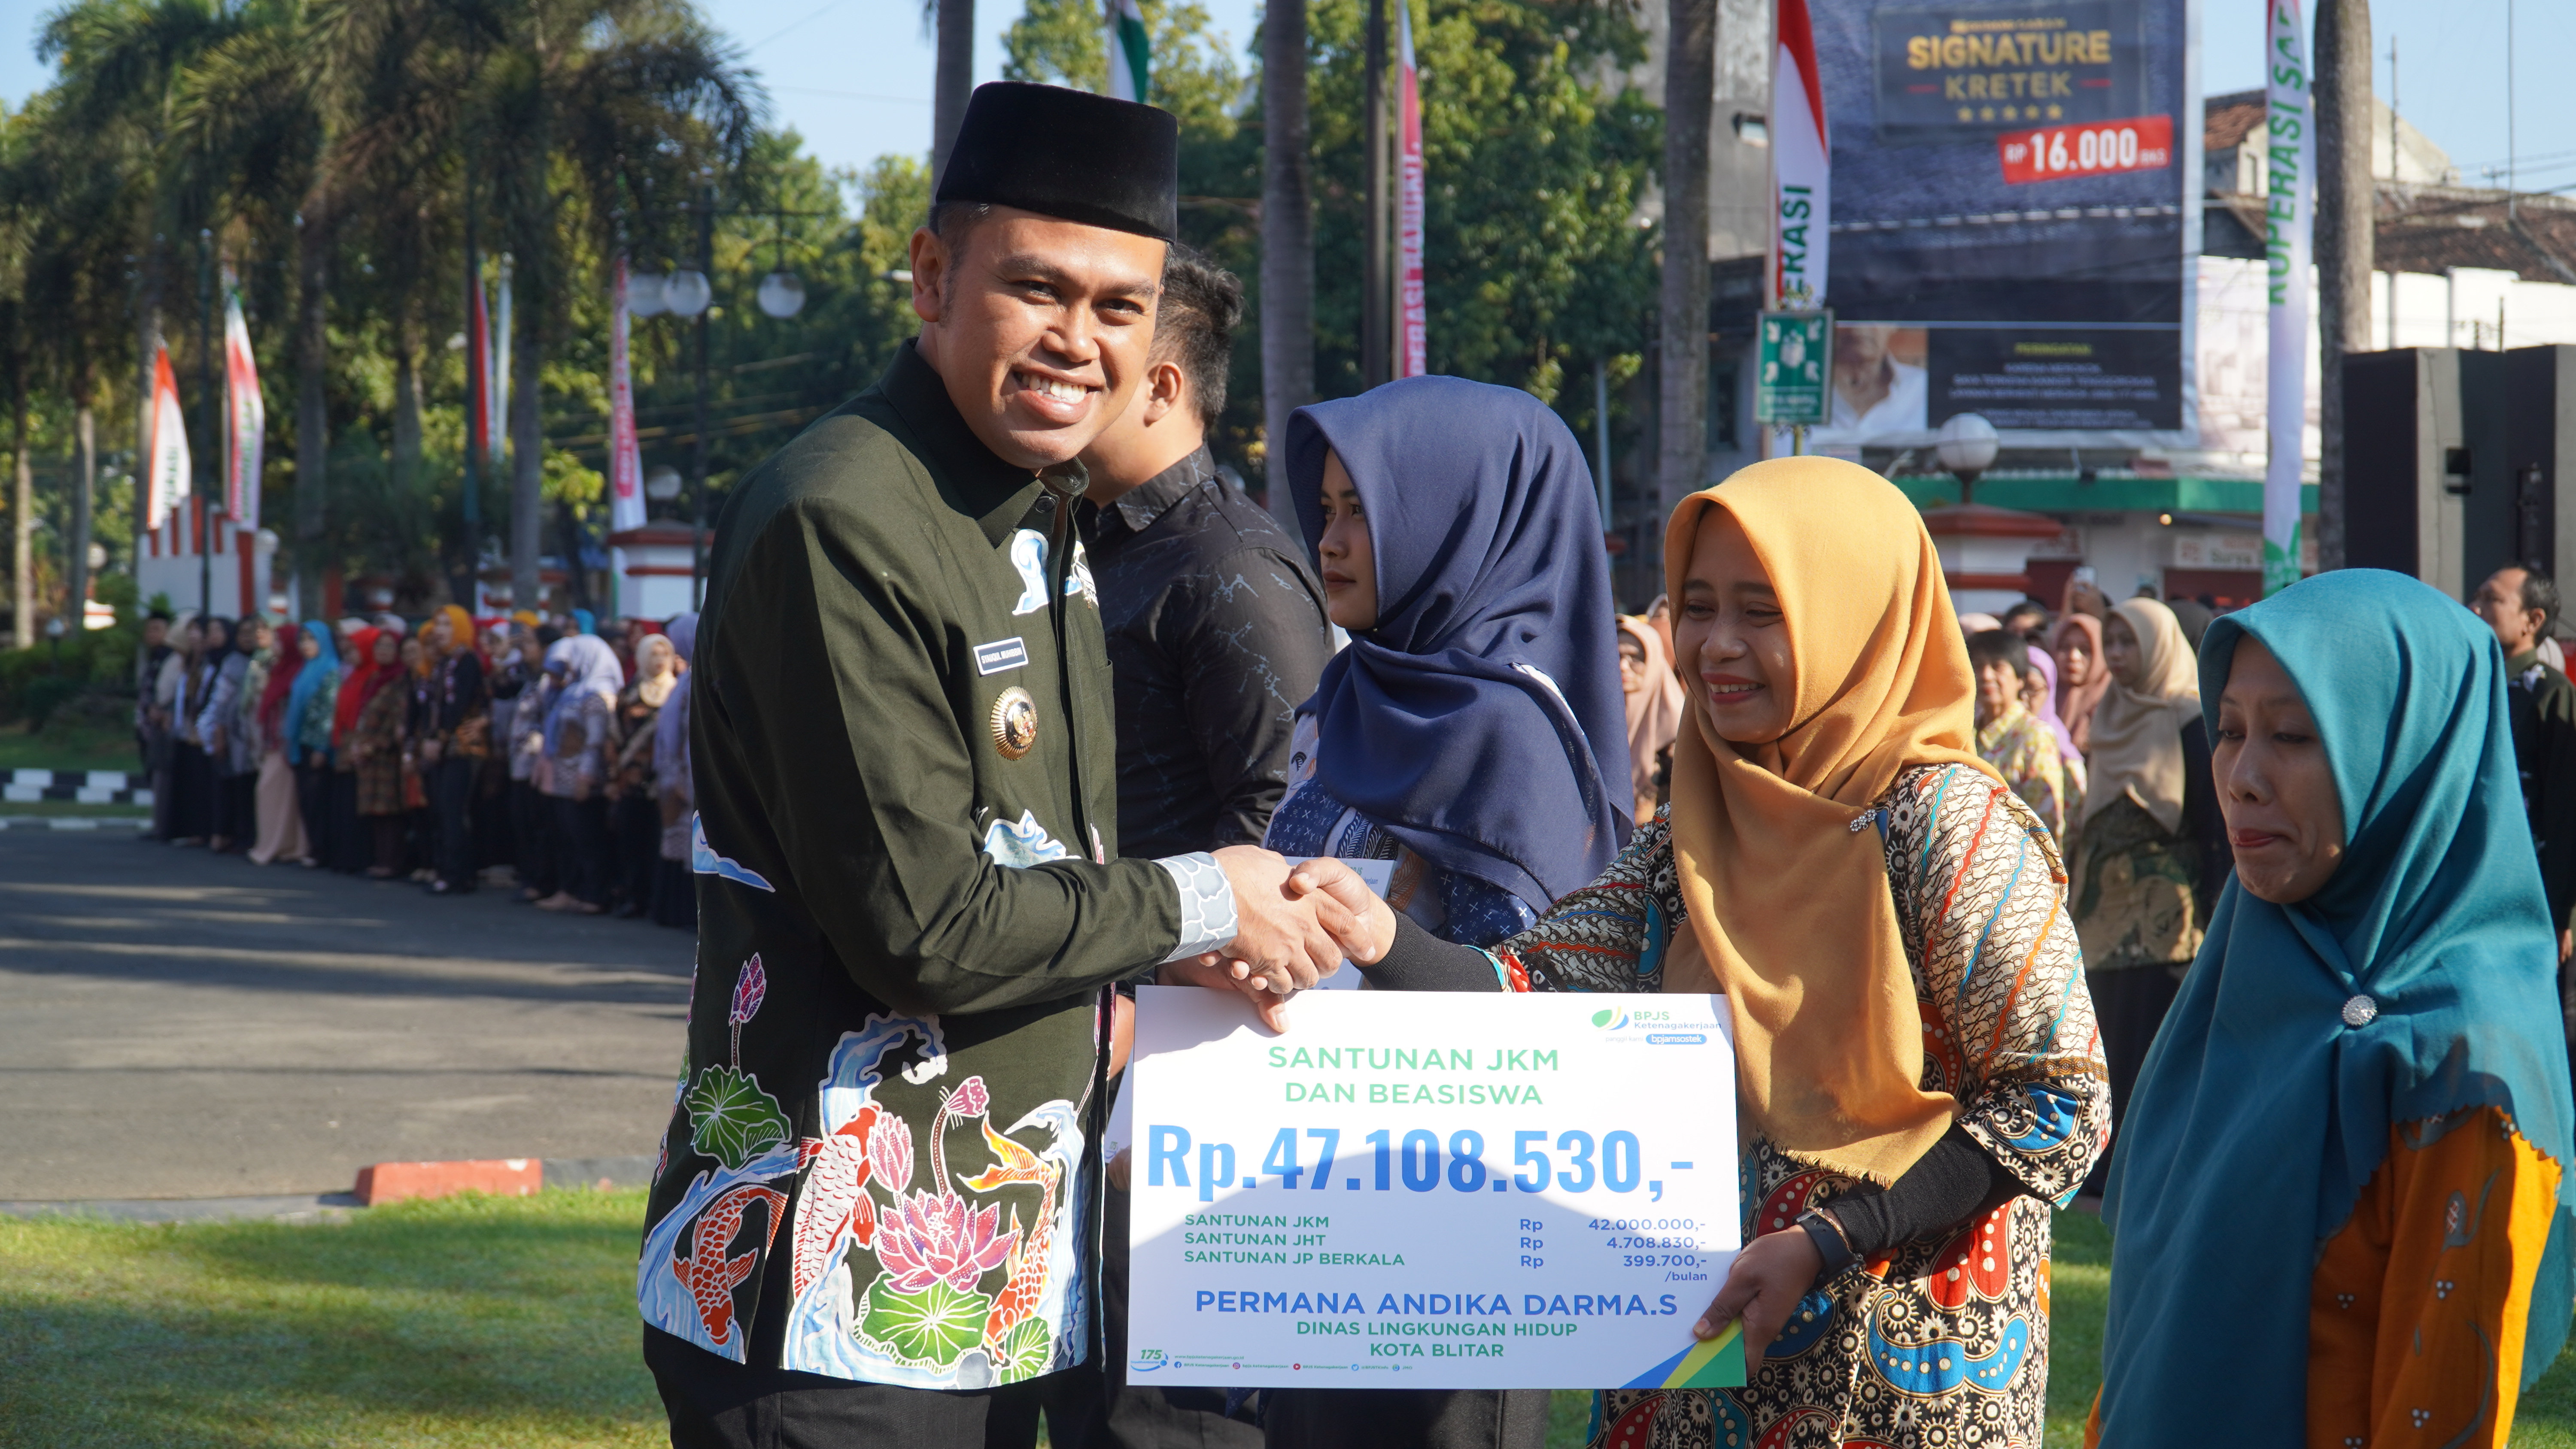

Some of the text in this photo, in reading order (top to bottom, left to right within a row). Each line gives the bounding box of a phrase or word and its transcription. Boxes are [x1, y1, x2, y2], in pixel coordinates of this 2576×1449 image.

[1907, 30, 2111, 69] SIGNATURE
[1945, 71, 2072, 101] KRETEK
[2030, 128, 2138, 172] 16.000
[1781, 185, 1812, 294] ERASI
[981, 647, 1022, 664] SYAUQUL MUHIBBIN
[1634, 1012, 1669, 1020] BPJS
[1651, 1035, 1702, 1044] bpjamsostek
[1269, 1047, 1557, 1070] SANTUNAN JKM
[1286, 1083, 1542, 1104] DAN BEASISWA
[1149, 1125, 1692, 1201] Rp.47.108.530,-
[1185, 1214, 1705, 1232] SANTUNAN JKM Rp 42.000.000,-
[1185, 1233, 1705, 1250] SANTUNAN JHT Rp 4.708.830,-
[1185, 1251, 1706, 1269] SANTUNAN JP BERKALA Rp 399.700,-
[1665, 1271, 1707, 1282] /bulan
[1197, 1291, 1677, 1315] PERMANA ANDIKA DARMA.S
[1297, 1322, 1577, 1336] DINAS LINGKUNGAN HIDUP
[1141, 1349, 1162, 1359] 175
[1371, 1343, 1503, 1356] KOTA BLITAR
